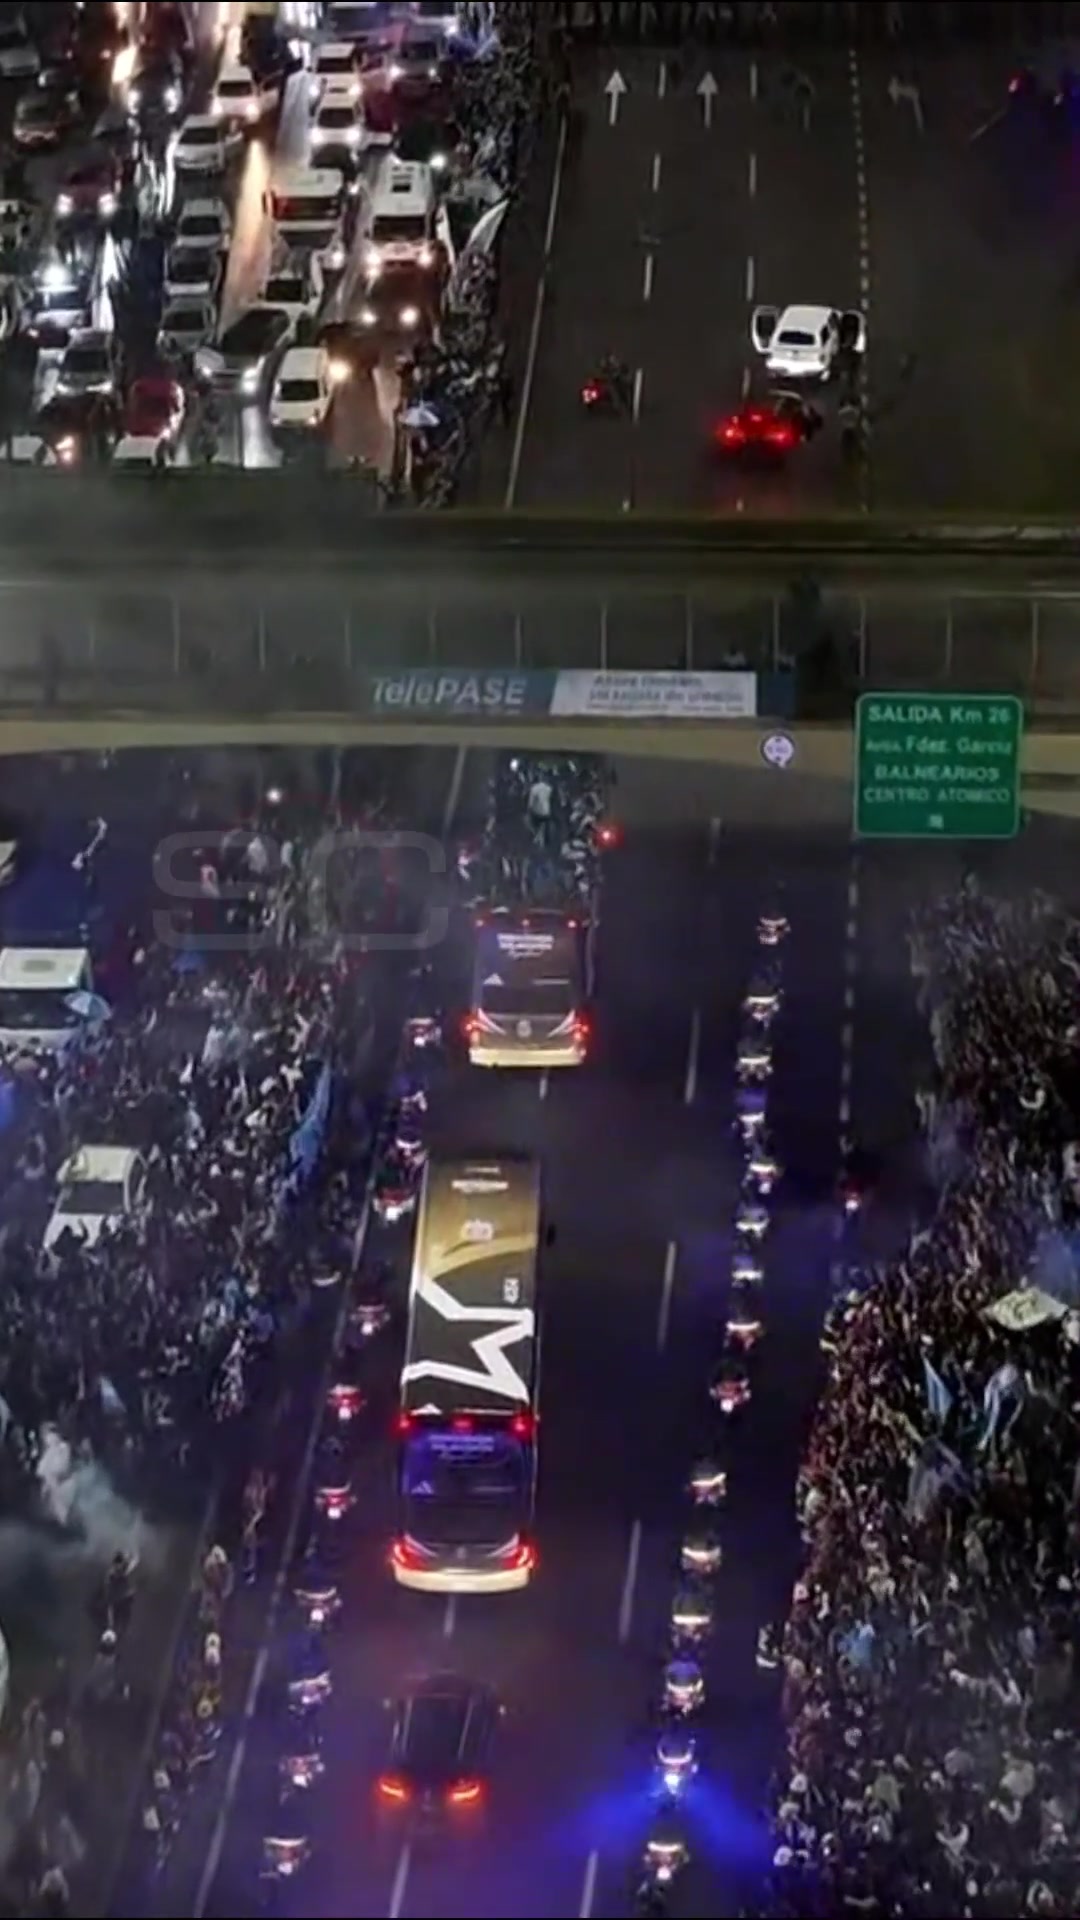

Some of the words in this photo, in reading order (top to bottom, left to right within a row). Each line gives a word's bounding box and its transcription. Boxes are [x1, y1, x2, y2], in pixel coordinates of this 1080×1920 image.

[371, 676, 528, 705] TelePASE
[868, 705, 943, 724] SALIDA
[950, 706, 983, 724] Km
[874, 764, 1000, 782] BALNEARIOS
[863, 786, 930, 804] CENTRO
